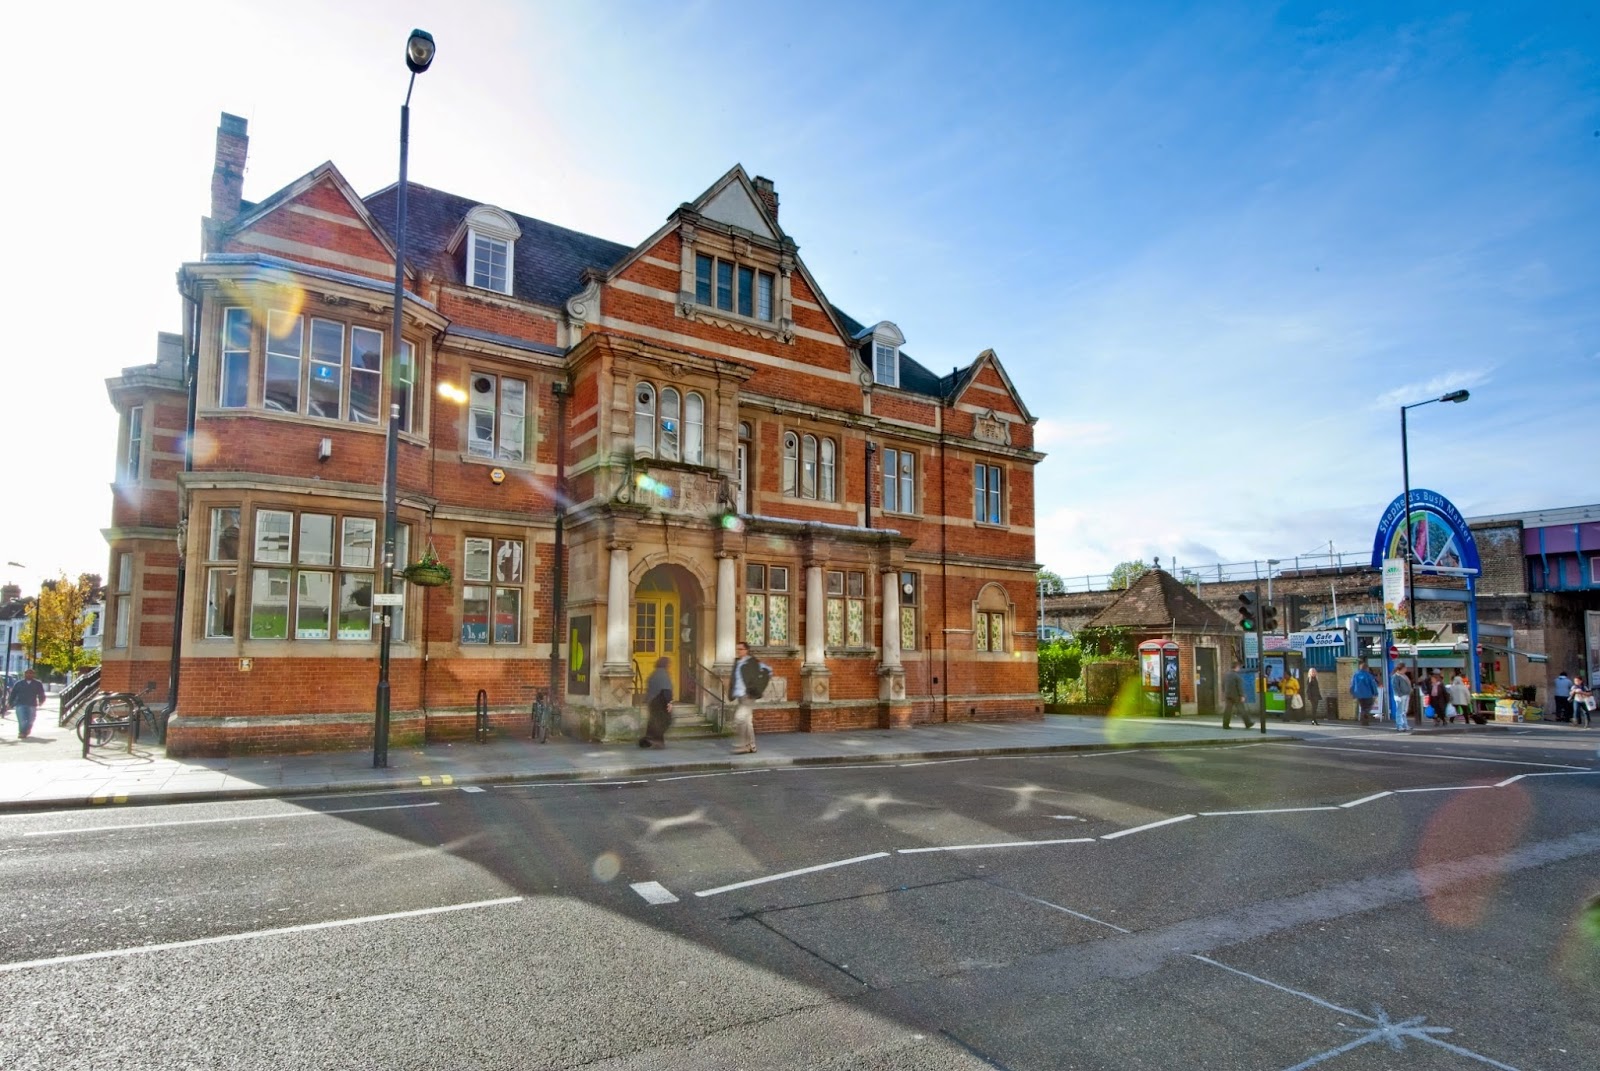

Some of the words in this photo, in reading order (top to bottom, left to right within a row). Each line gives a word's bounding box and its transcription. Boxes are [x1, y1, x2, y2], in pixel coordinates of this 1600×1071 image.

[1380, 492, 1420, 534] Shephed's
[1423, 491, 1444, 507] Bush
[1446, 505, 1471, 543] Market
